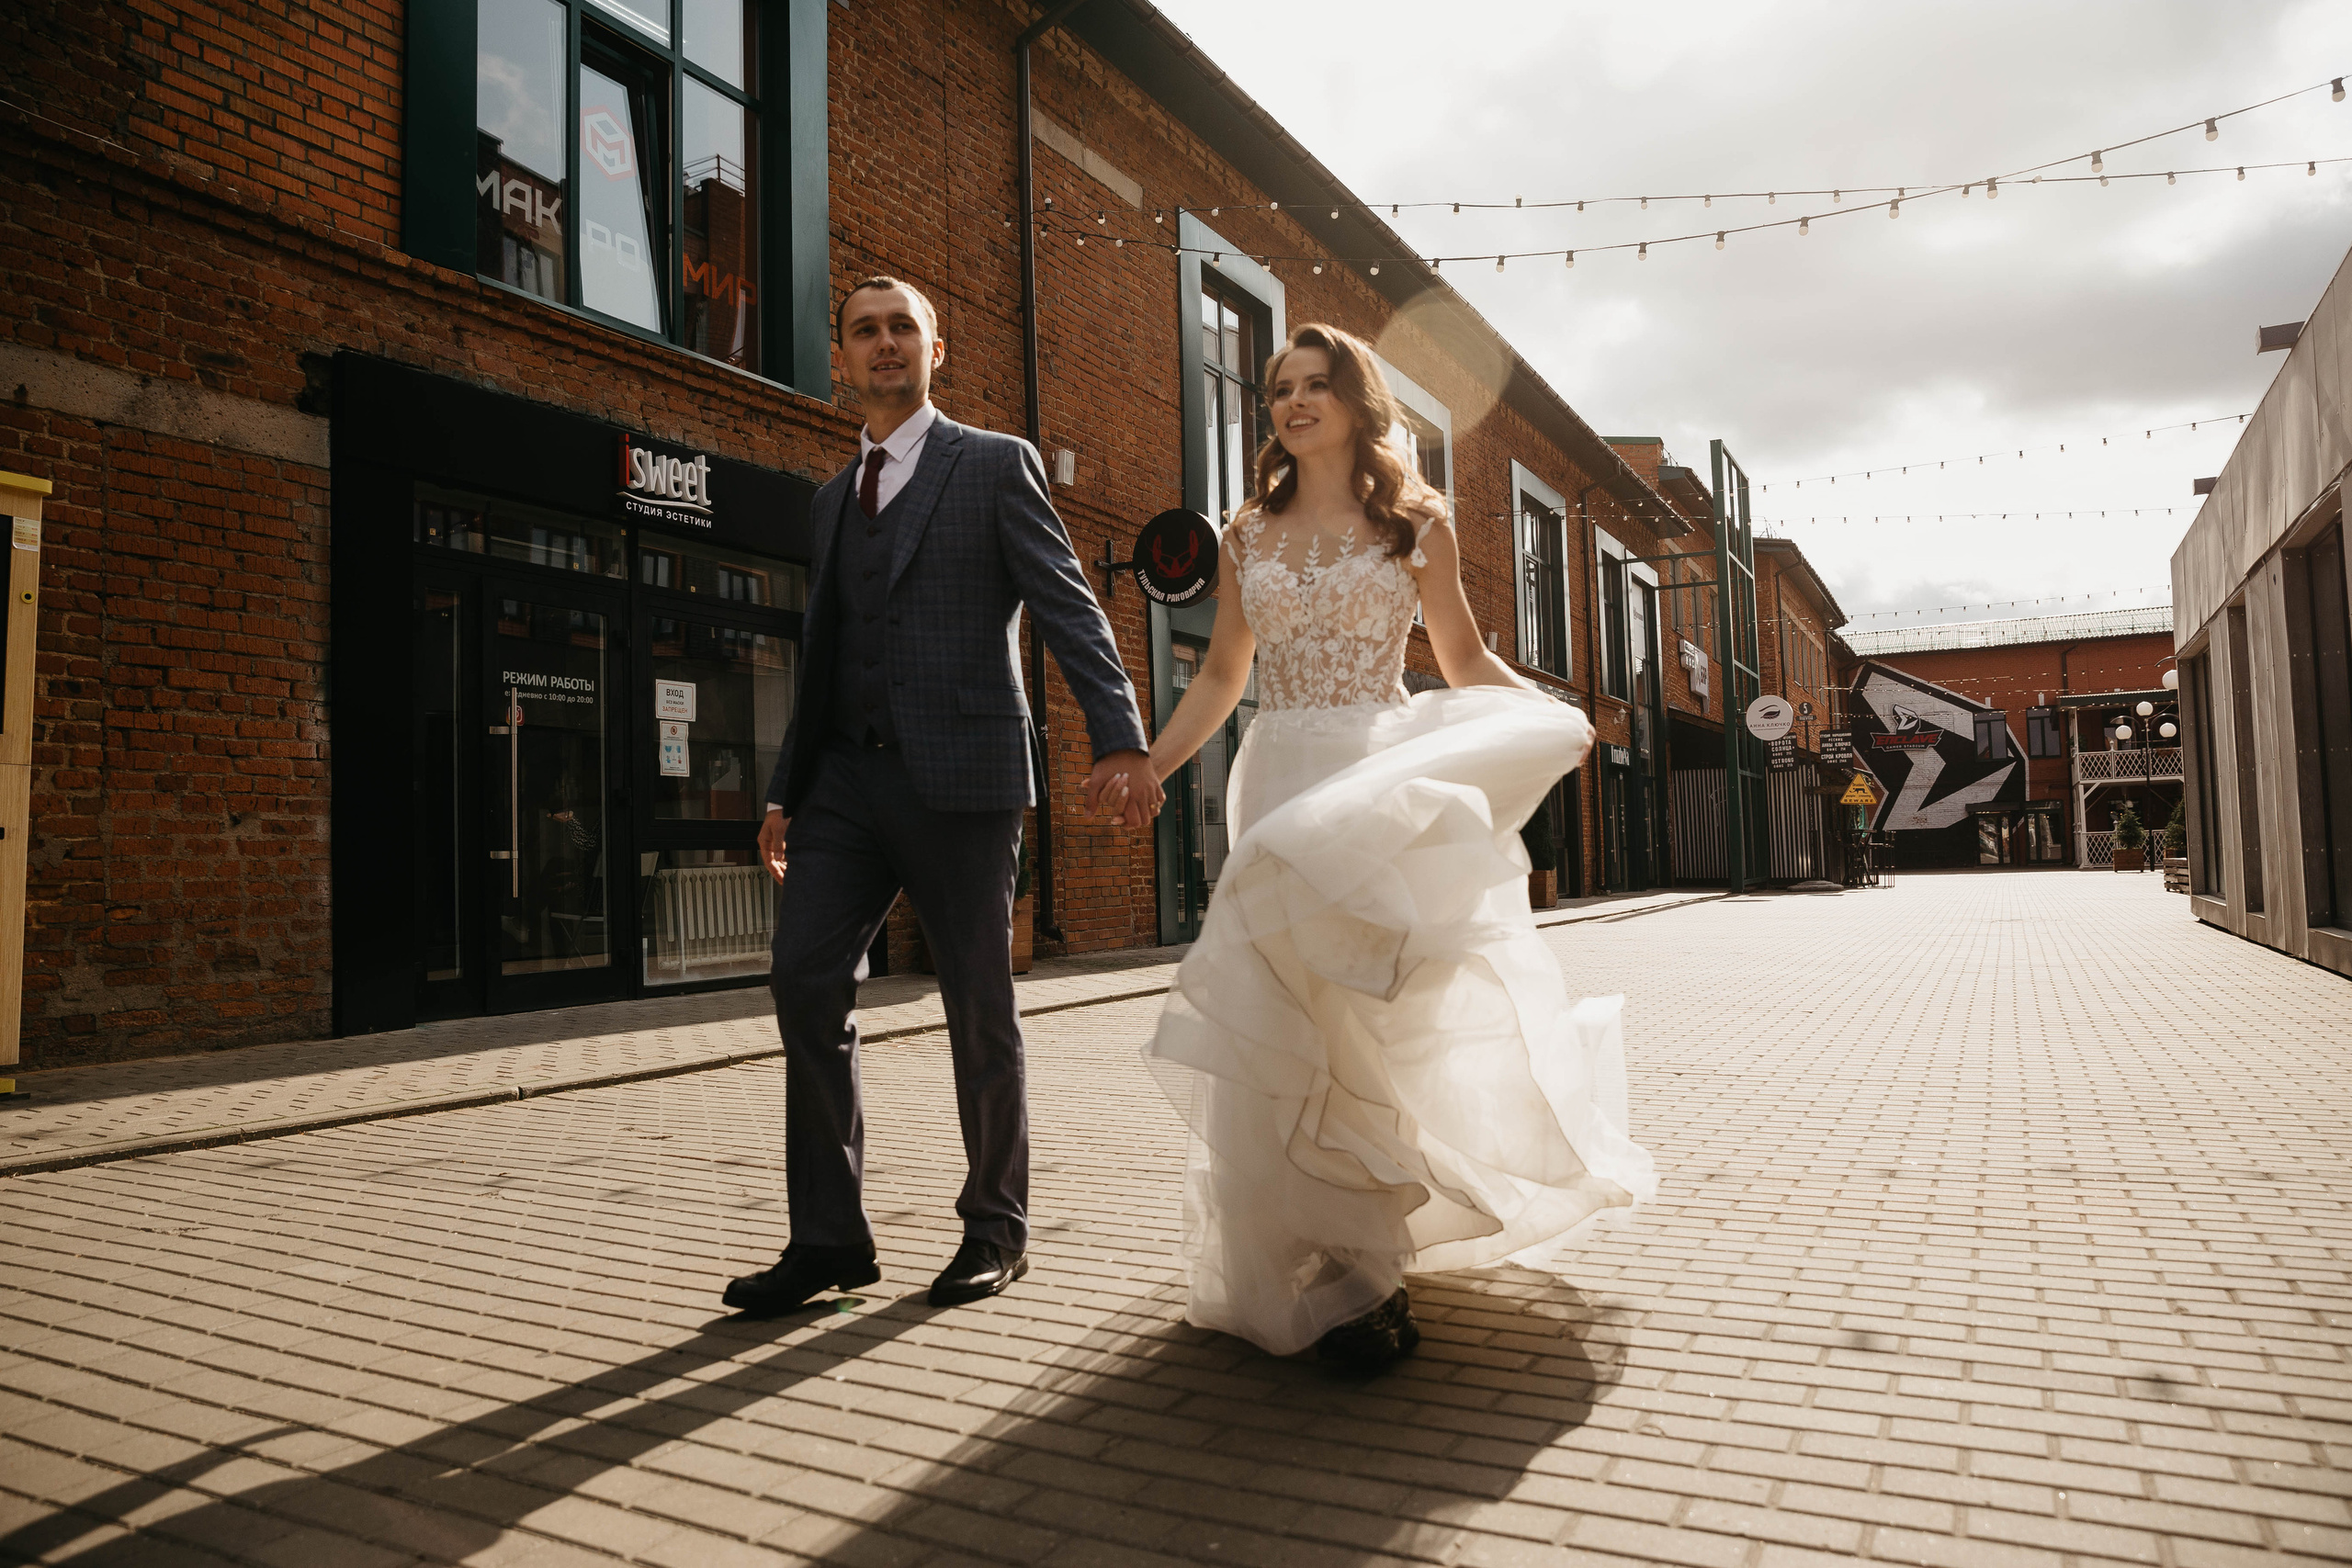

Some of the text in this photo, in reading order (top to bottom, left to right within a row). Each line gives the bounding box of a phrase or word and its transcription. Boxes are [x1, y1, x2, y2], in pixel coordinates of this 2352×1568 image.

[477, 170, 562, 236] МАК
[683, 253, 757, 309] МИР
[626, 501, 712, 528] СТУДИЯ ЭСТЕТИКИ
[1137, 569, 1205, 603] ТУЛЬСКАЯ РАКОВАРНЯ
[503, 671, 594, 692] РЕЖИМ РАБОТЫ
[548, 693, 566, 702] 10:00
[576, 695, 594, 704] 20:00
[666, 689, 684, 699] ВХОД
[1803, 703, 1808, 714] 5
[1875, 733, 1939, 745] ENCLAVE
